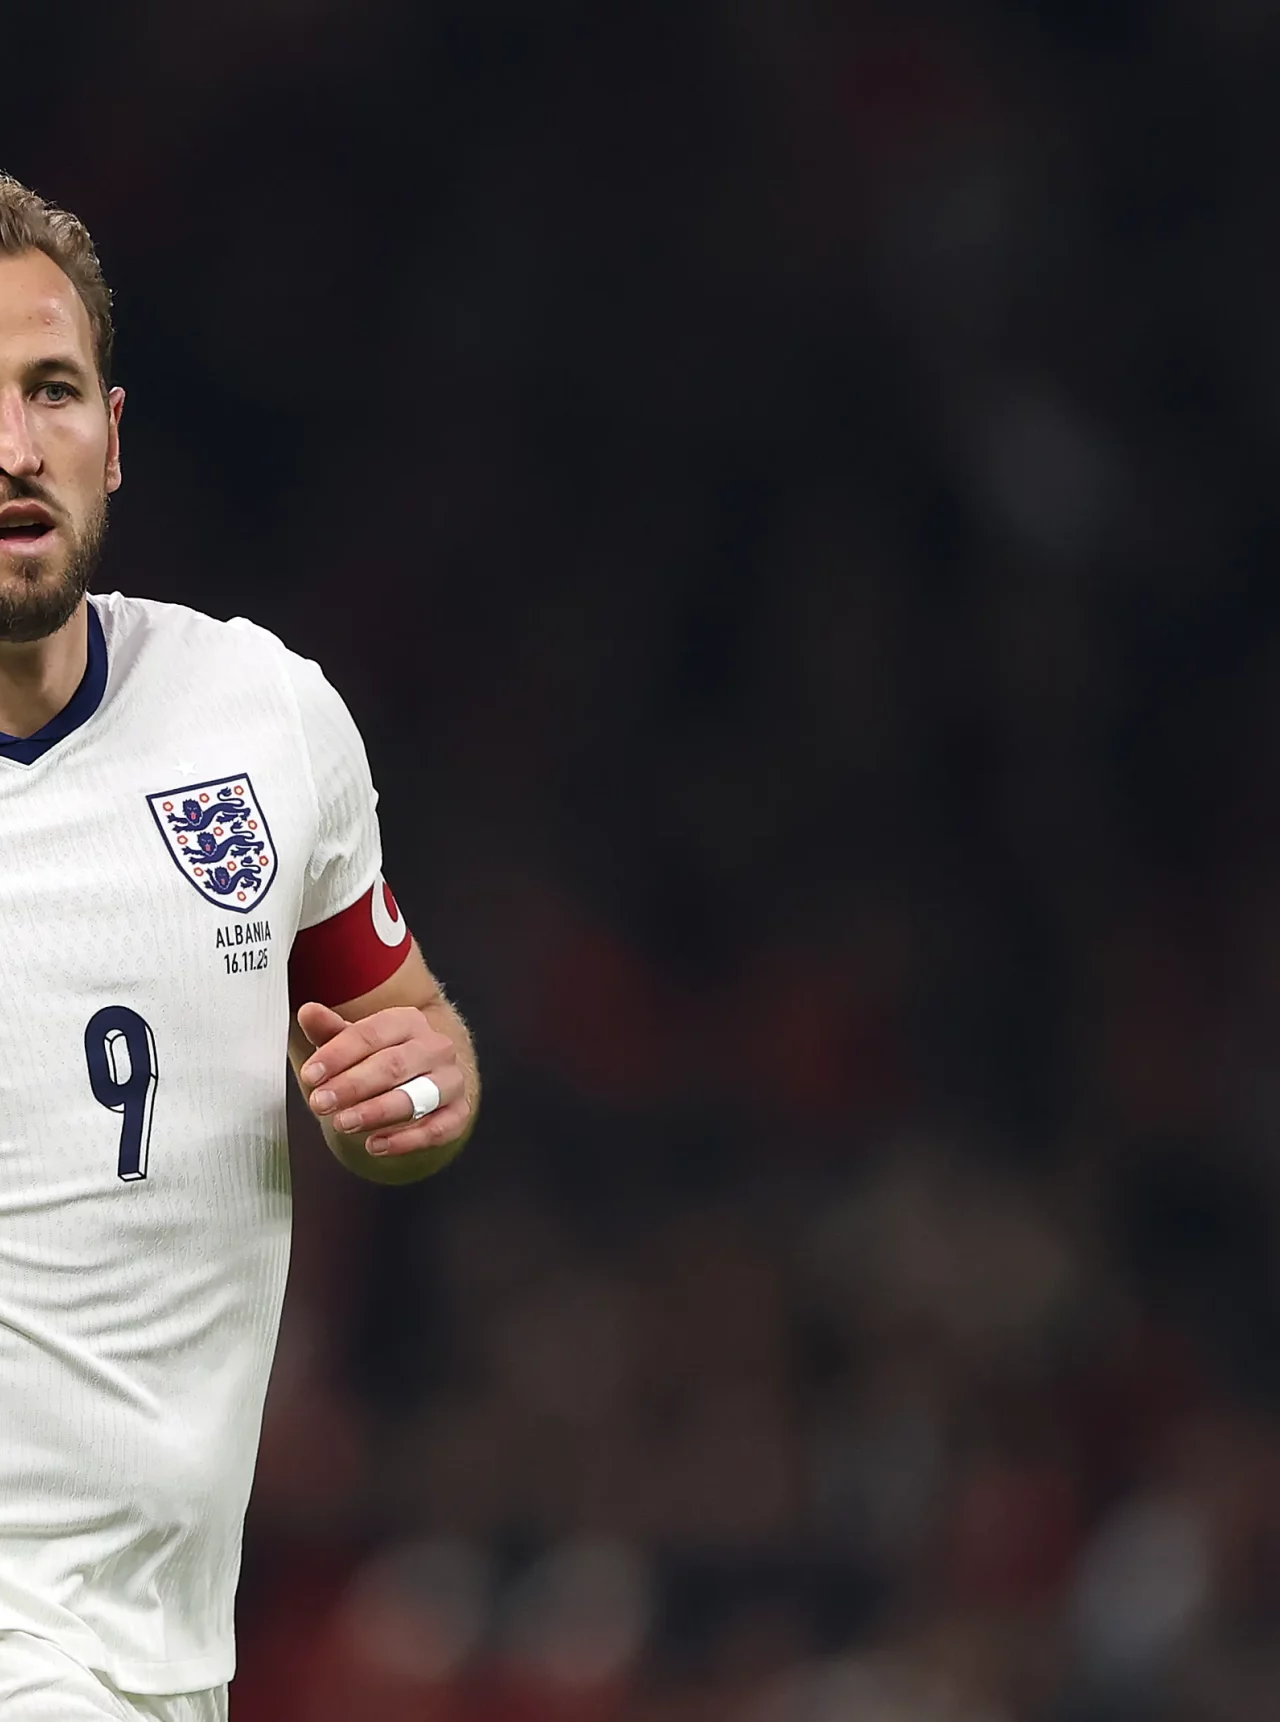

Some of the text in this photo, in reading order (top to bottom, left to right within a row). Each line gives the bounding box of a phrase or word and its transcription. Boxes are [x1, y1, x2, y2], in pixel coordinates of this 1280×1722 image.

[216, 921, 271, 948] ALBANIA
[224, 948, 268, 974] 16.11.25
[84, 1005, 158, 1182] 9
